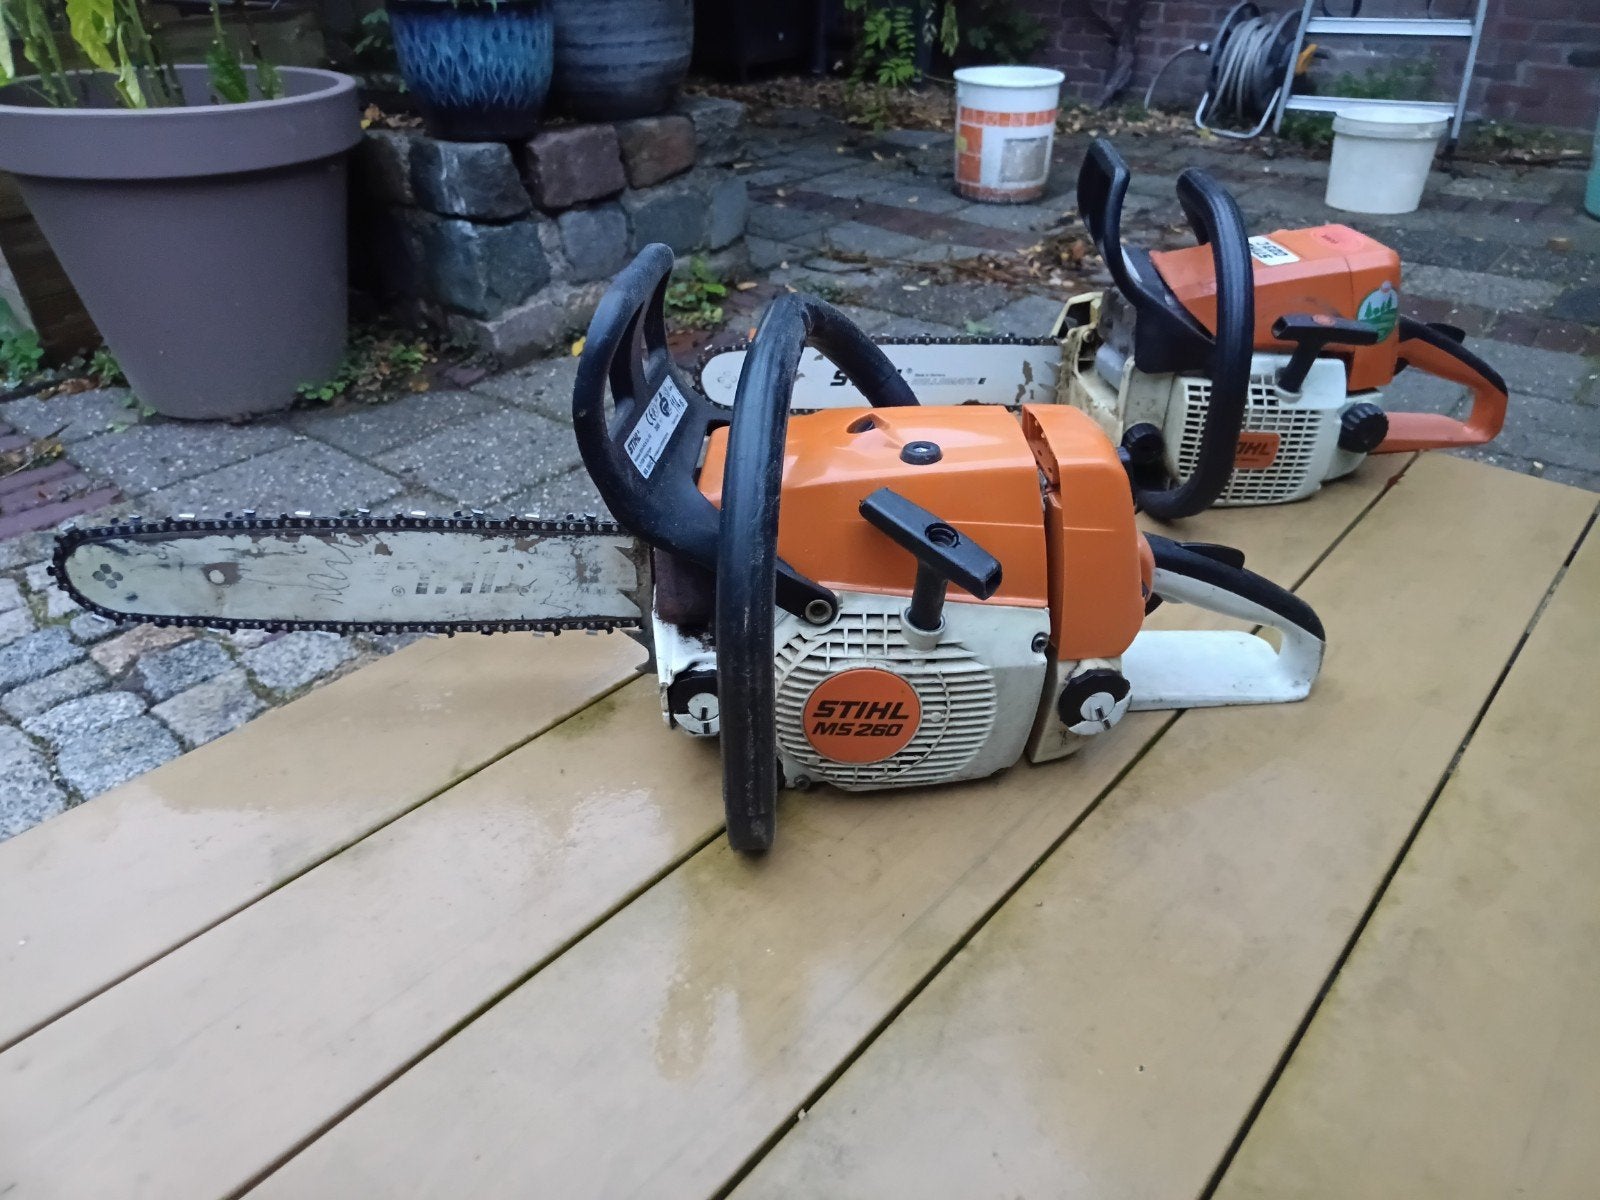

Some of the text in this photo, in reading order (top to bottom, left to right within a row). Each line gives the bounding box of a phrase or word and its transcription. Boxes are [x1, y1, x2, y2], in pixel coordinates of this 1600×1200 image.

[812, 700, 909, 720] STIHL
[812, 721, 904, 736] MS 260
